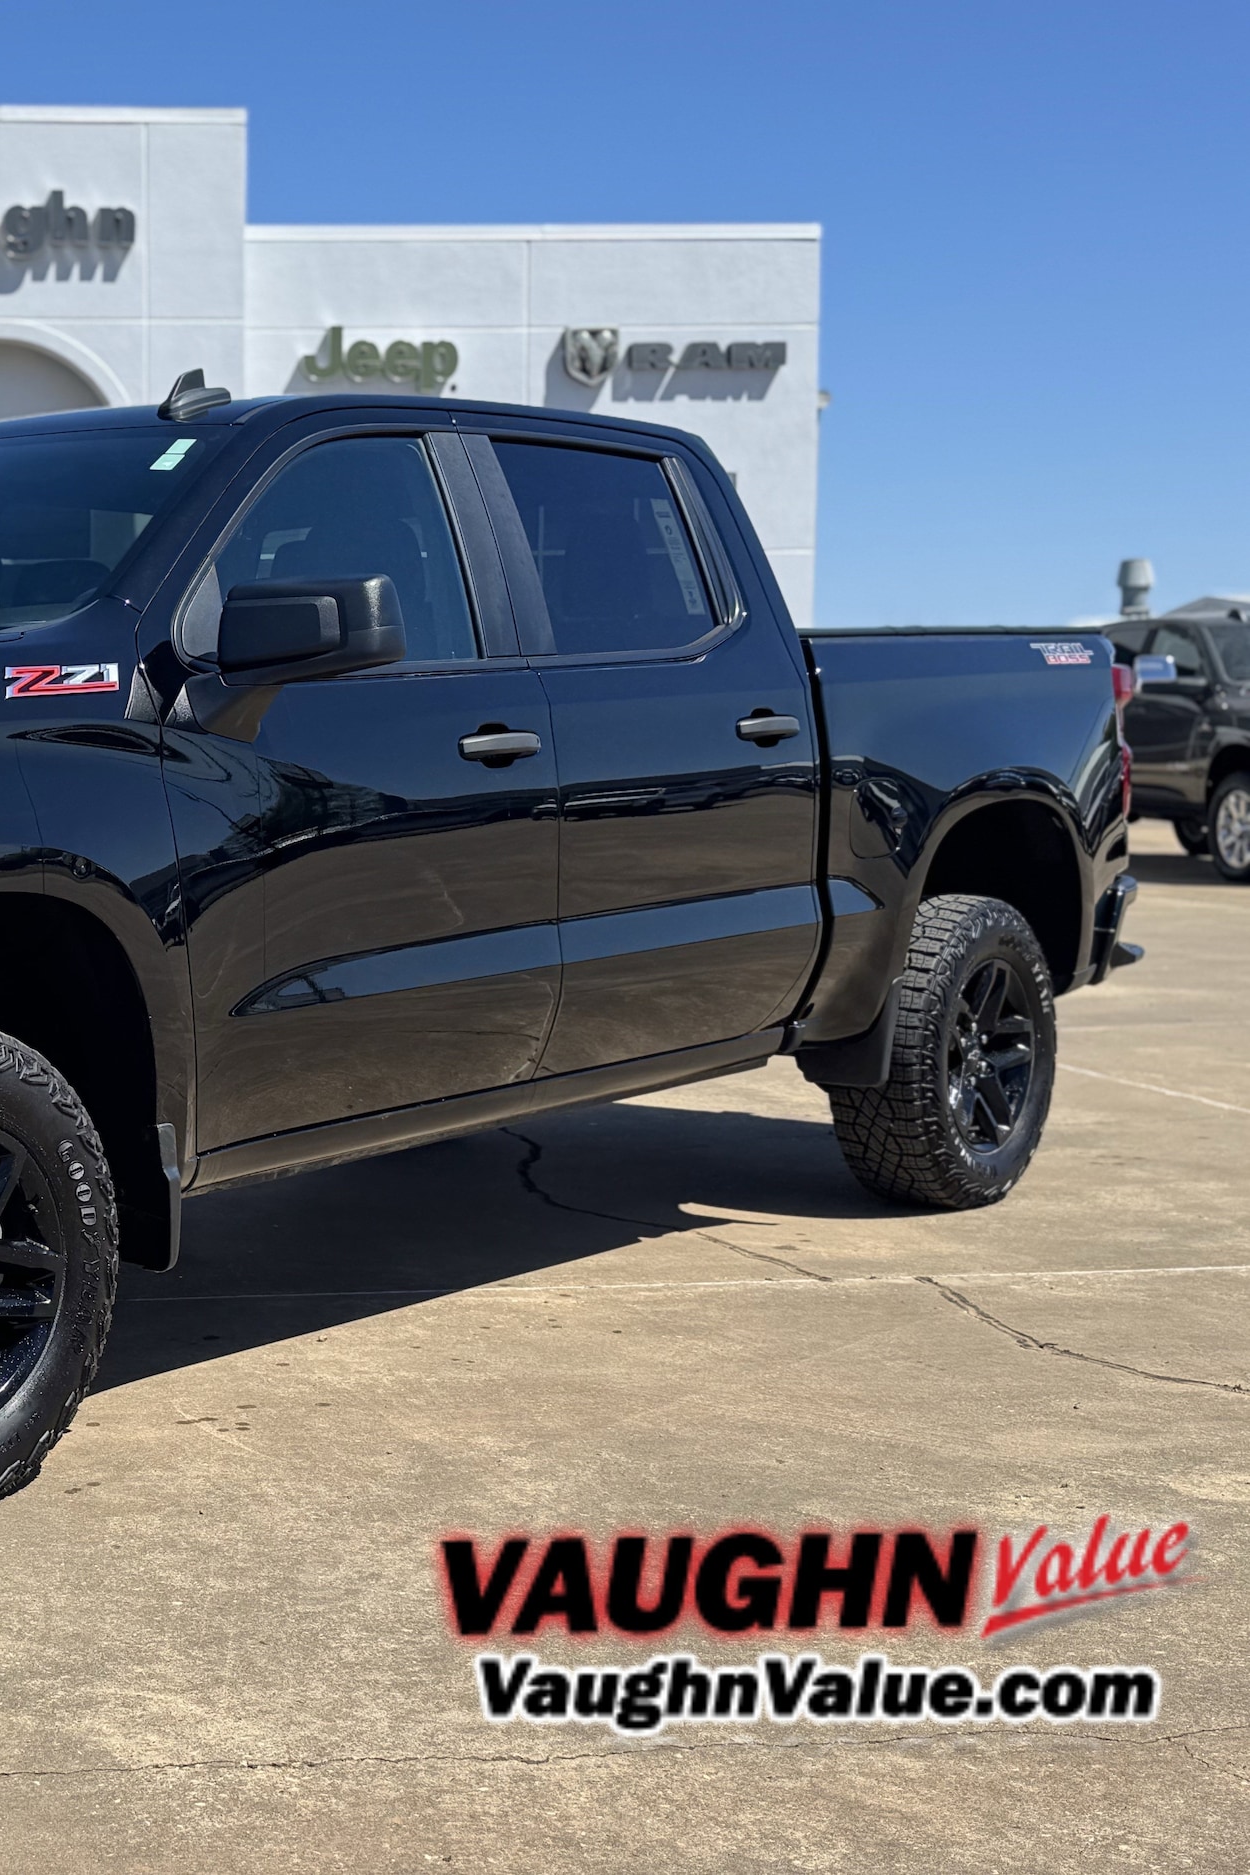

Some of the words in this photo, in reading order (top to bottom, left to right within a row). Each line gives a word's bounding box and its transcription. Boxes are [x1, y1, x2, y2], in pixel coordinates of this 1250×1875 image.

[304, 326, 459, 391] Jeep
[627, 341, 787, 371] RAM
[1030, 642, 1094, 655] TRAIL
[1044, 654, 1091, 665] BOSS
[4, 662, 120, 701] Z71
